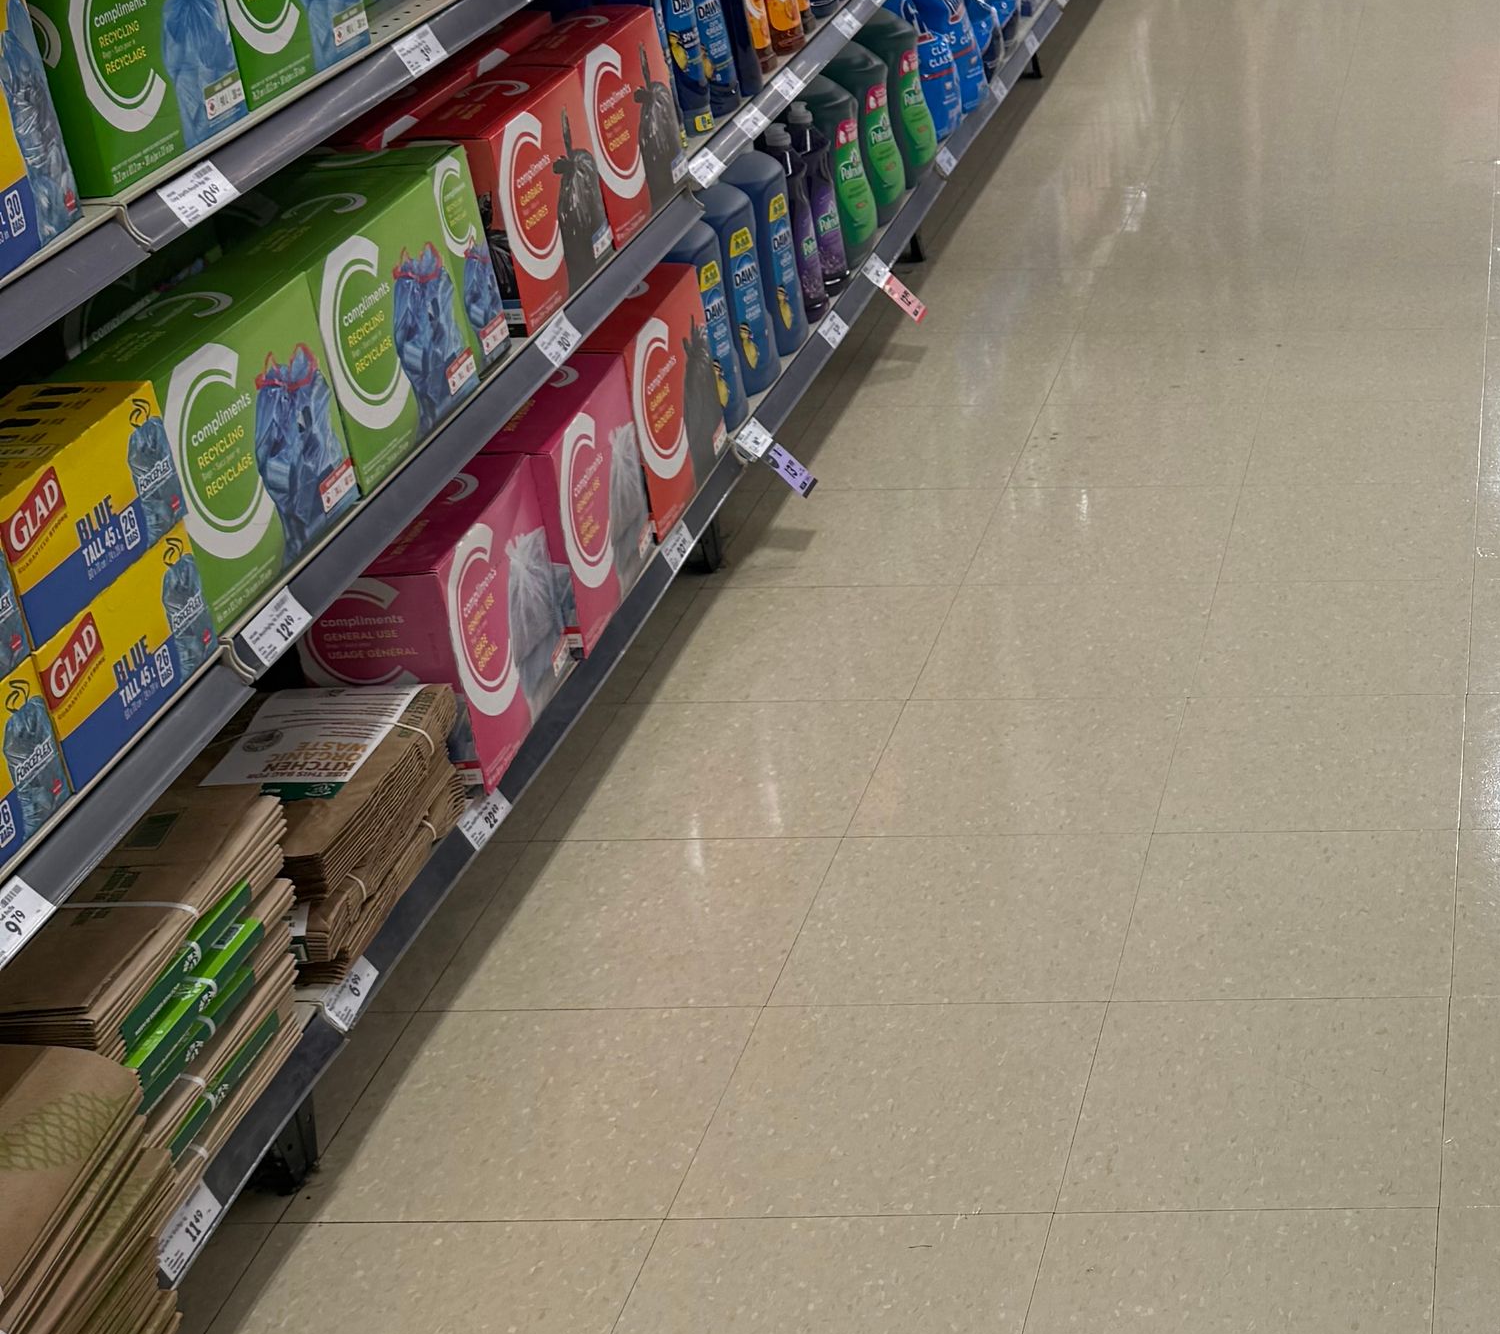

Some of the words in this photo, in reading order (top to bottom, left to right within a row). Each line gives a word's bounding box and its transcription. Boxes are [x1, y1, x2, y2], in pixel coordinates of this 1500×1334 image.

[98, 20, 141, 49] RECYCLING
[106, 46, 147, 75] RECYCLAGE
[7, 194, 23, 216] 30
[734, 261, 760, 291] DAWN
[343, 281, 391, 327] compliments
[347, 310, 385, 348] RECYCLING
[355, 334, 393, 375] RECYCLAGE
[191, 390, 252, 447] compliments
[198, 425, 245, 470] RECYCLING
[205, 452, 254, 499] RECYCLAGE
[9, 478, 60, 552] GLAD
[122, 509, 135, 531] 26
[82, 536, 106, 566] TALL
[105, 524, 117, 548] 45
[320, 613, 405, 629] compliments
[323, 630, 373, 643] GENERAL
[375, 629, 401, 641] USE
[51, 624, 97, 699] GLAD
[328, 648, 364, 661] USAGE
[119, 677, 141, 706] TALL
[140, 664, 152, 688] 45
[265, 751, 362, 763] ORGANIC
[297, 741, 368, 753] WASTE
[263, 761, 356, 773] KITCHEN
[4, 909, 26, 937] 979
